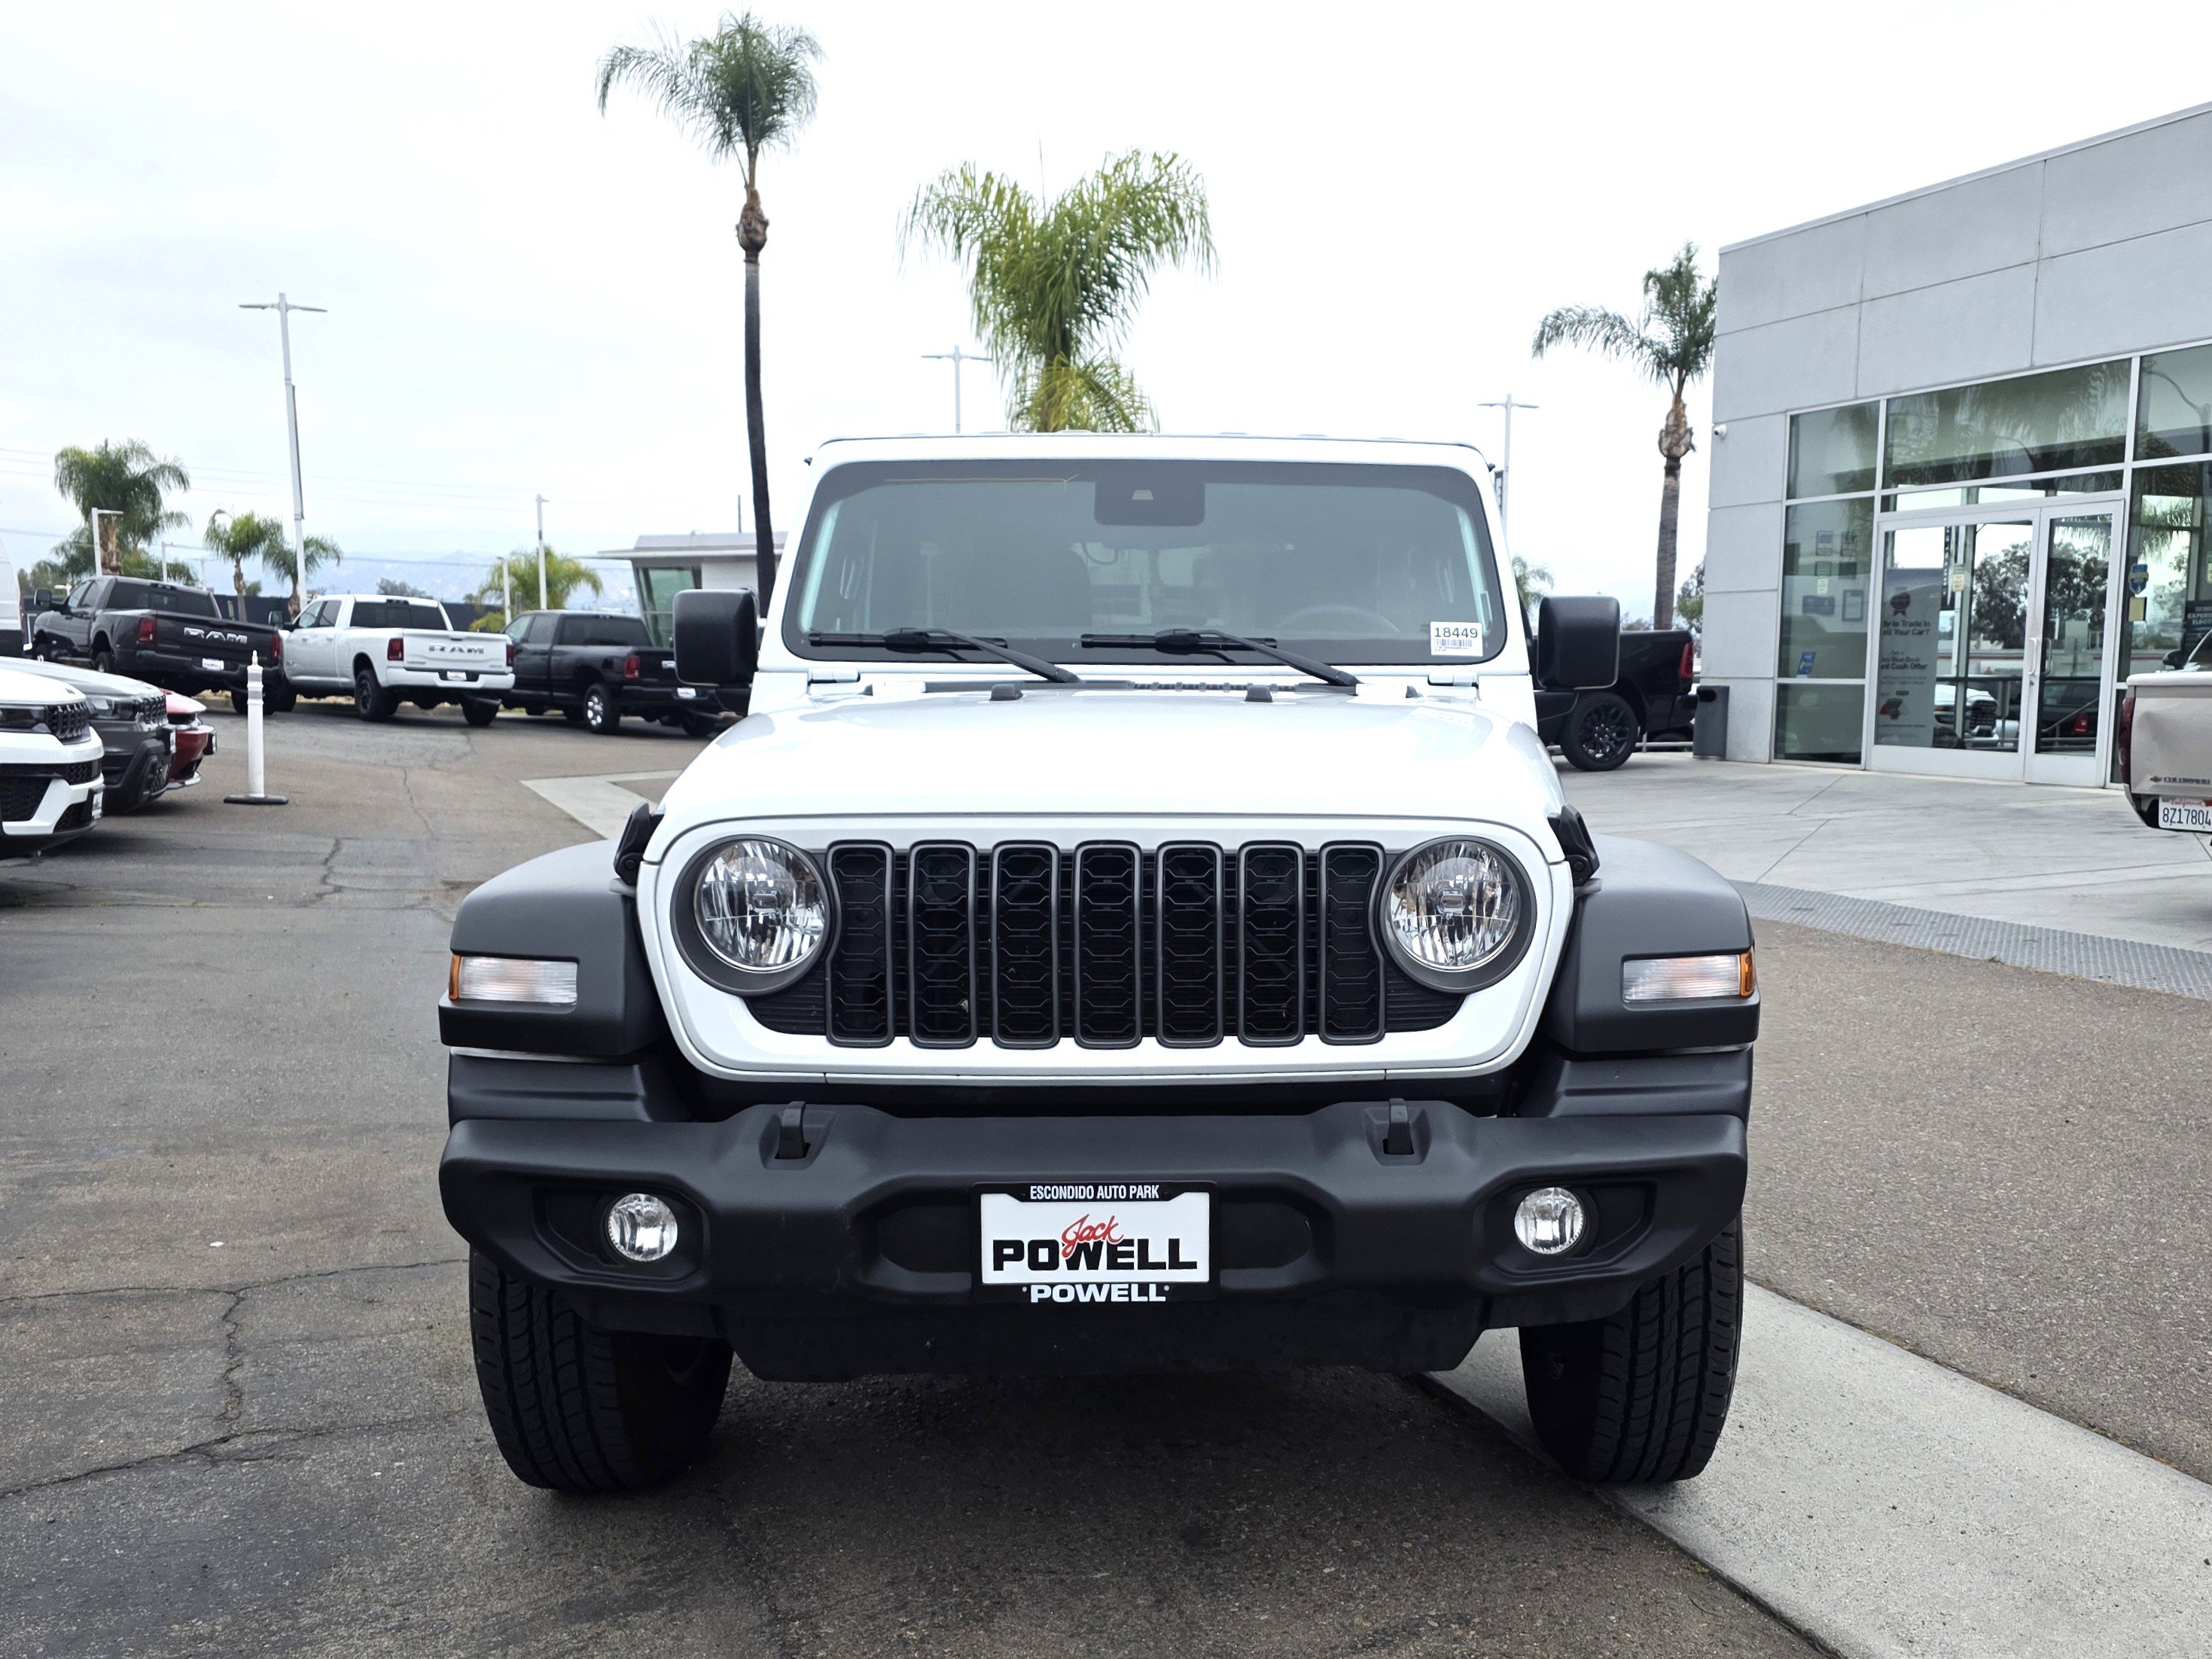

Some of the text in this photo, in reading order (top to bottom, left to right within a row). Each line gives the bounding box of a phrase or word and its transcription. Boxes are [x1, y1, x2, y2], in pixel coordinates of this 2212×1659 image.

[184, 627, 247, 645] RAM
[1434, 627, 1478, 639] 18449
[428, 643, 484, 654] RAM
[2162, 807, 2211, 826] 8Z17804
[1030, 1185, 1159, 1200] ESCONDIDO AUTO PARK
[1061, 1213, 1124, 1259] Jack
[992, 1237, 1198, 1272] POWELL
[1030, 1283, 1166, 1304] POWELL
